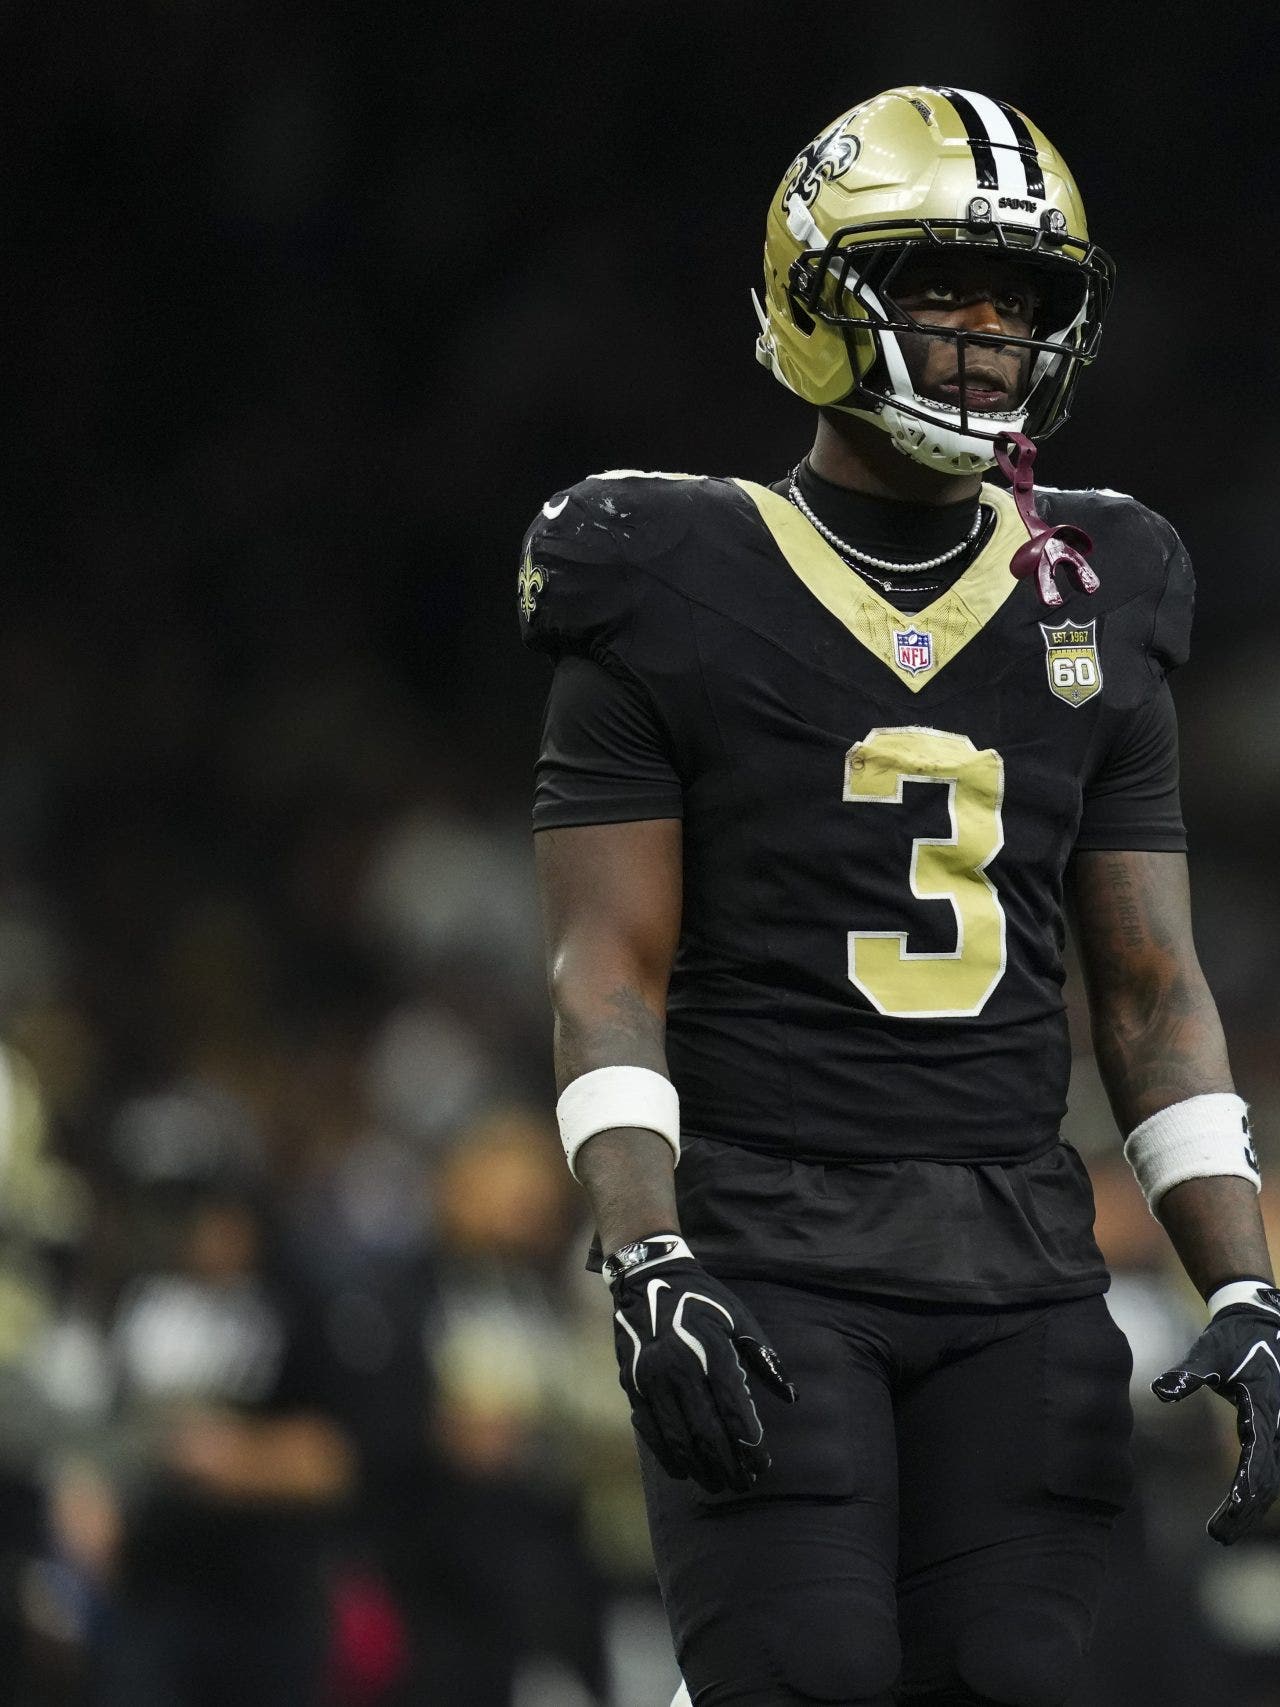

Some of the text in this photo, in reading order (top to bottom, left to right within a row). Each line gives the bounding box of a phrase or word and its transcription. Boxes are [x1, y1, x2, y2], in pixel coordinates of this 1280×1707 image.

[1052, 630, 1089, 644] EST. 1967
[900, 646, 928, 667] NFL
[1052, 656, 1097, 688] 60
[842, 725, 1007, 1019] 3
